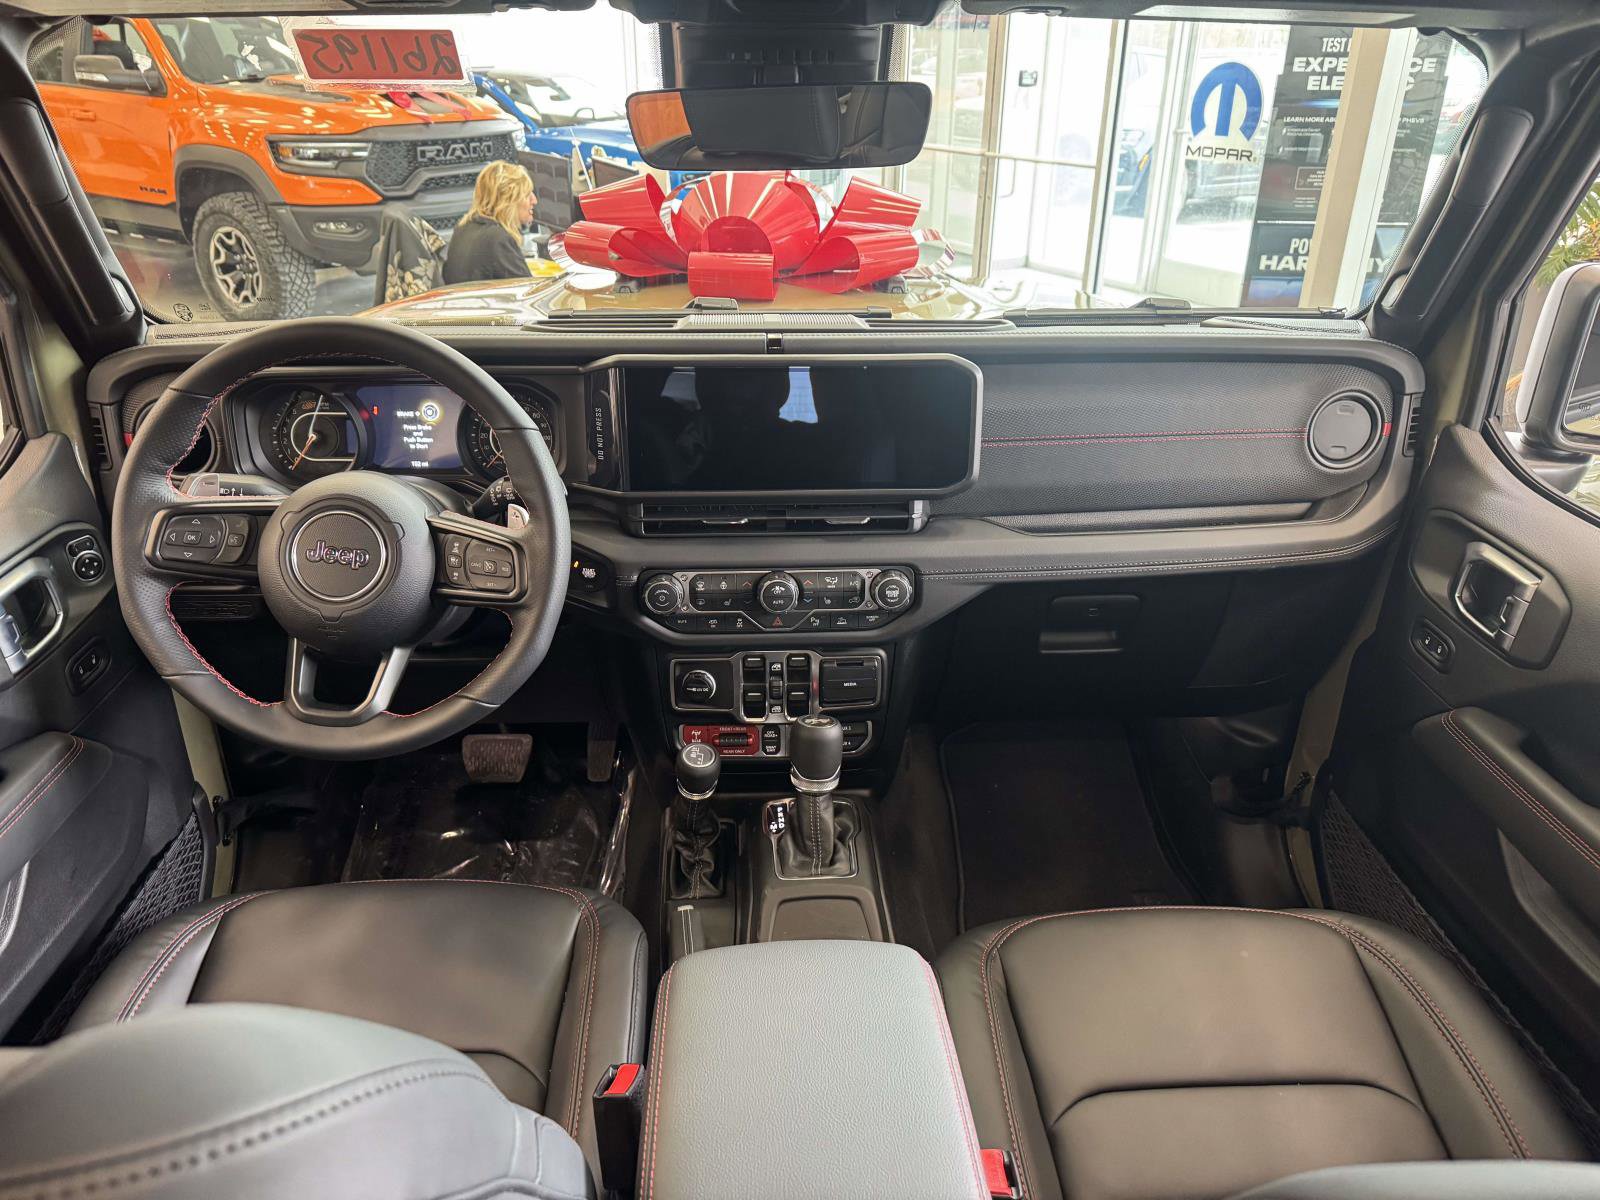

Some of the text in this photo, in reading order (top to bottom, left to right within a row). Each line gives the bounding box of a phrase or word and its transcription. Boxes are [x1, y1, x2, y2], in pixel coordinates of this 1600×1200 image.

[1322, 37, 1348, 53] TEST
[1292, 57, 1437, 73] EXPECE
[1307, 75, 1415, 91] ELEC
[417, 141, 493, 162] RAM
[1186, 145, 1253, 162] MOPAR
[596, 433, 604, 448] NOT
[306, 540, 370, 570] Jeep
